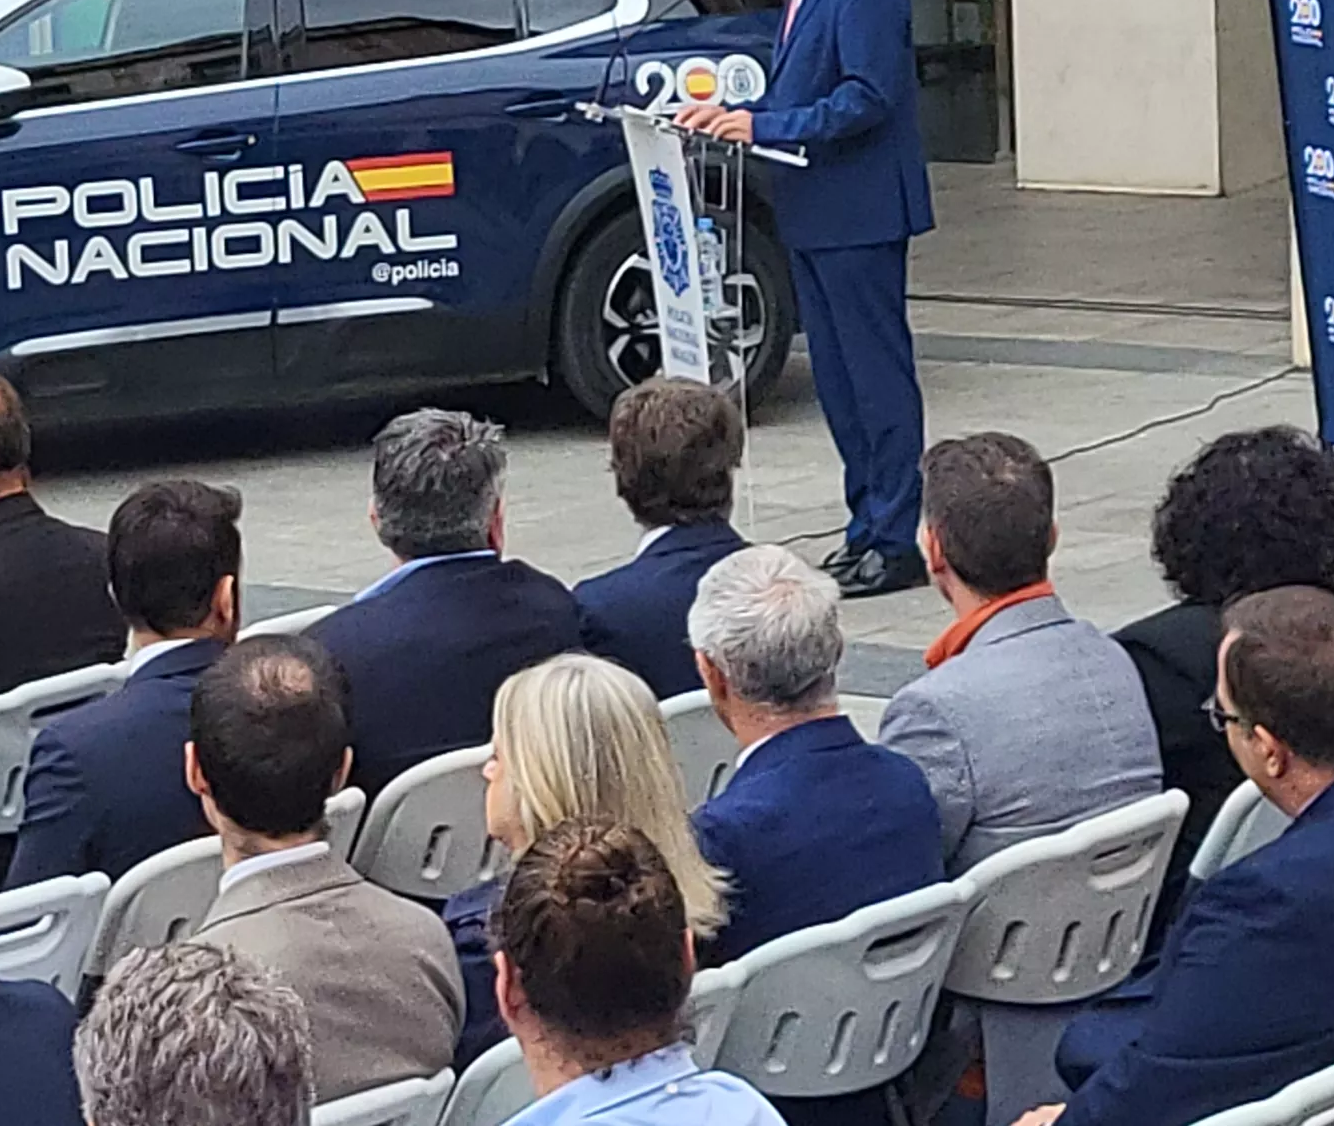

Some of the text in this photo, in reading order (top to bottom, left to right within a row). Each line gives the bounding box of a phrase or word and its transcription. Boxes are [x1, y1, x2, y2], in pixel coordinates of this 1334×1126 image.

[635, 53, 767, 117] 200
[1, 159, 366, 235] POLICIA
[4, 207, 459, 291] NACIONAL
[371, 258, 460, 287] @policia
